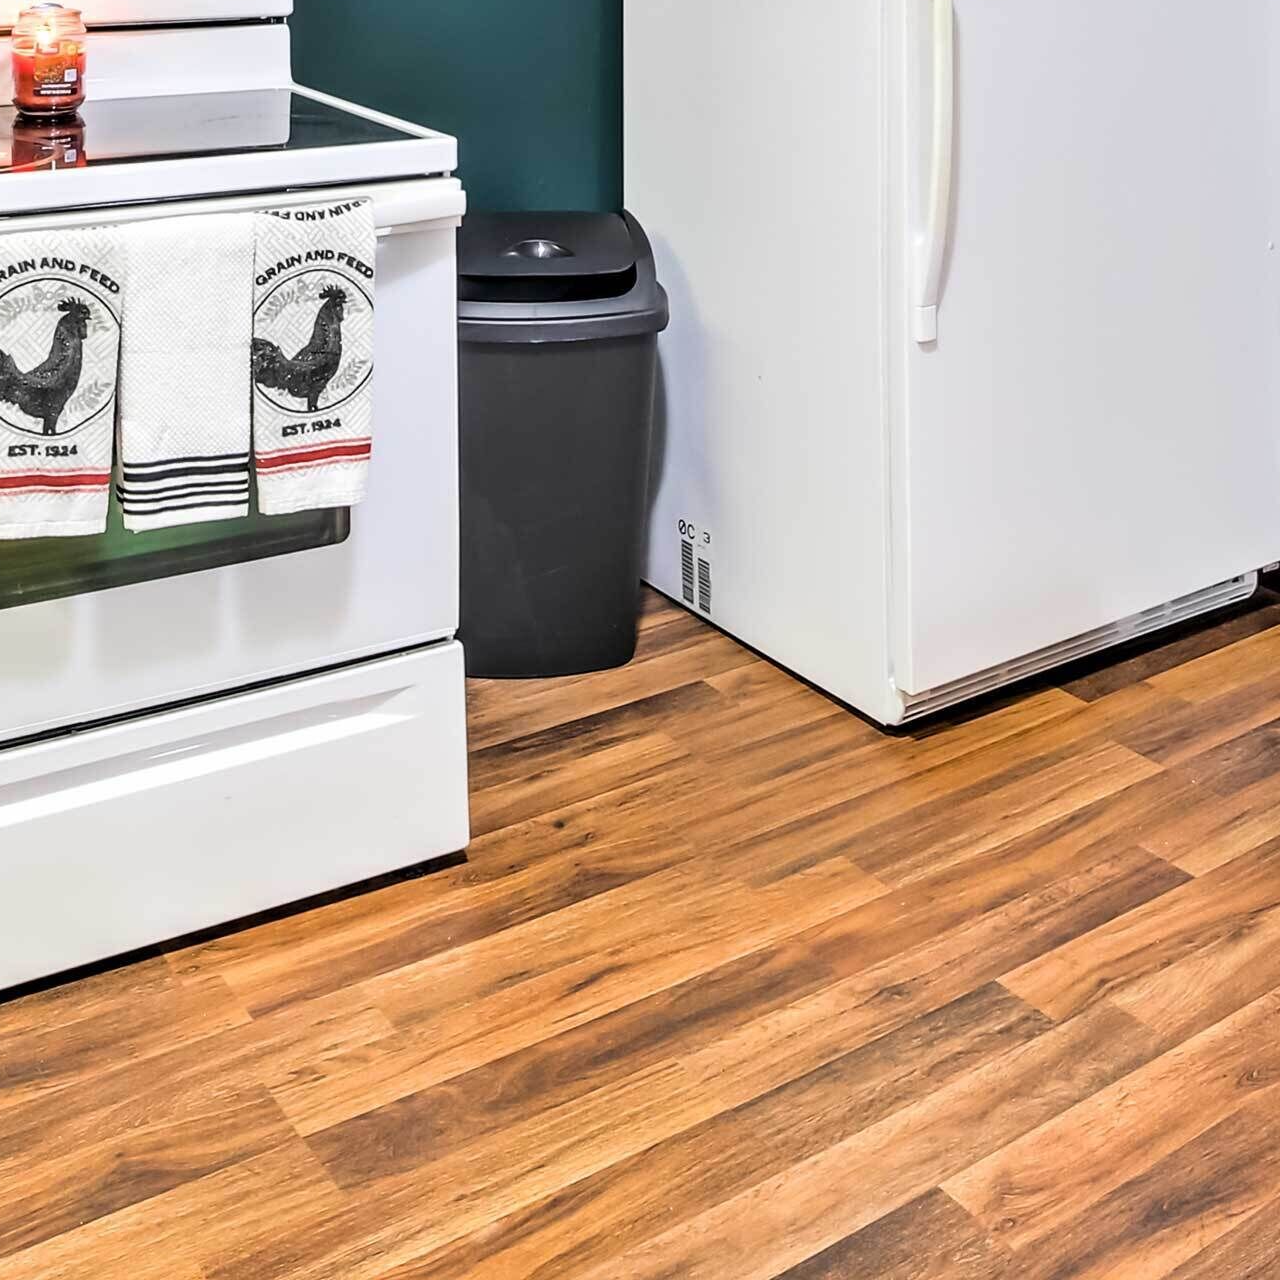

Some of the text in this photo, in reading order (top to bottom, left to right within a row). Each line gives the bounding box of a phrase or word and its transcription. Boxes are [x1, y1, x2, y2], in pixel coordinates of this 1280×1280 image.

[295, 210, 326, 222] AND
[255, 249, 374, 286] GRAIN AND FEED
[39, 257, 77, 272] AND
[78, 263, 121, 295] FEED
[281, 422, 310, 437] EST.
[7, 444, 41, 457] EST.
